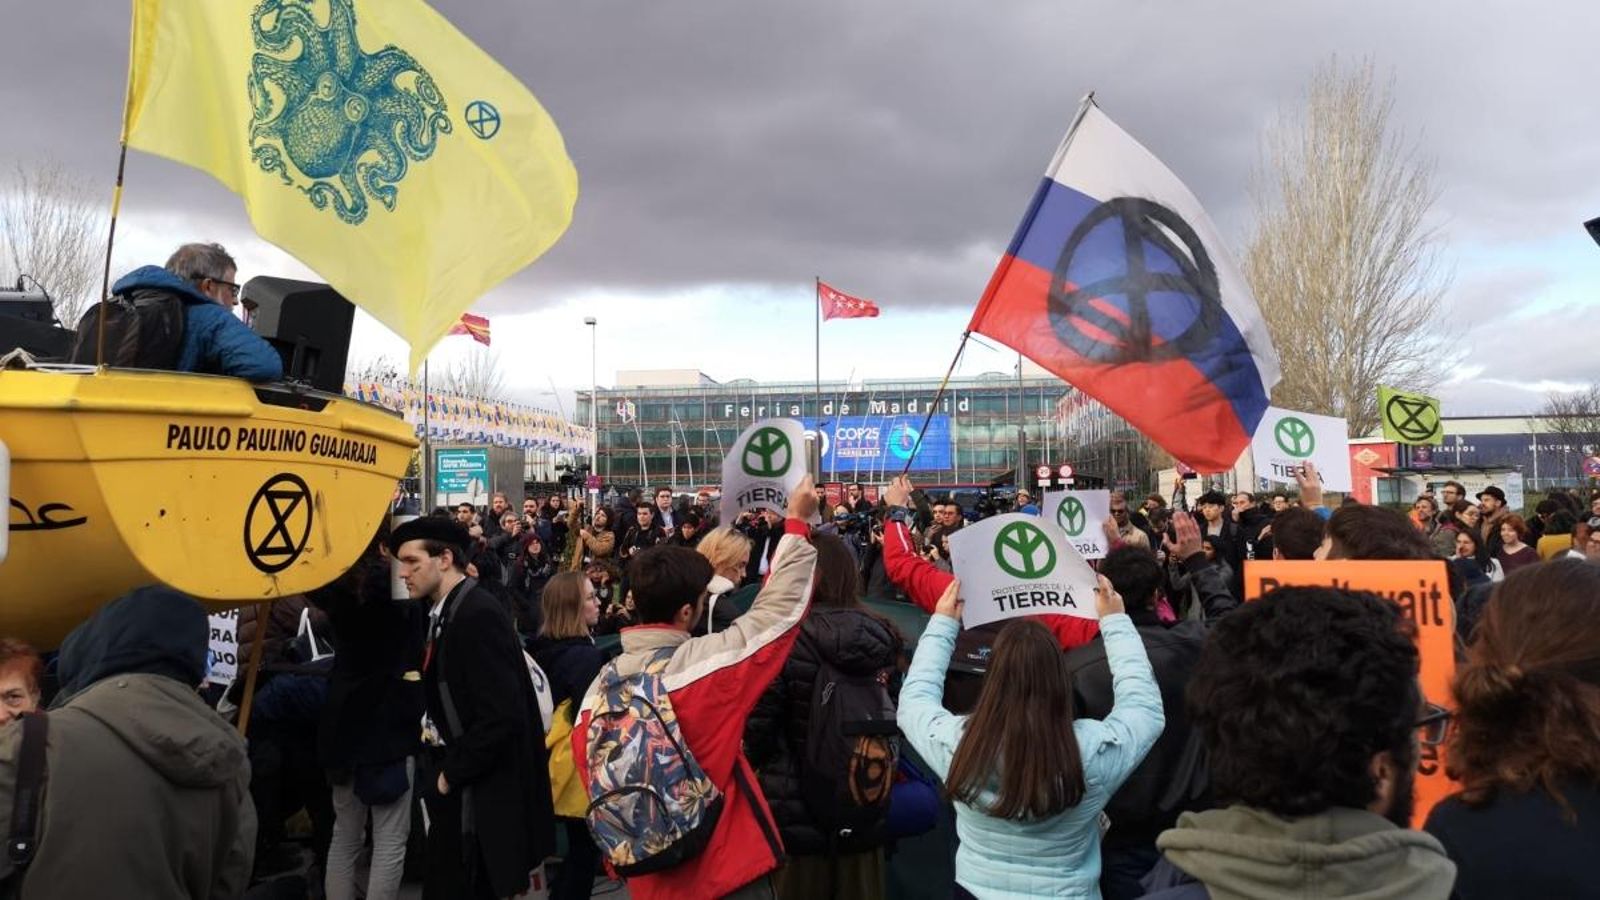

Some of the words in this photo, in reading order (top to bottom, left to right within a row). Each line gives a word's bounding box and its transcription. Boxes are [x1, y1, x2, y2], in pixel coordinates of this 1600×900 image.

[725, 404, 800, 417] Feria
[823, 402, 850, 416] de
[871, 397, 969, 415] Madrid
[836, 427, 880, 440] COP25
[167, 423, 231, 451] PAULO
[236, 427, 306, 453] PAULINO
[310, 433, 377, 465] GUAJARAJA
[991, 583, 1050, 596] PROTECTORES
[993, 591, 1077, 612] TIERRA
[1376, 579, 1444, 627] ait
